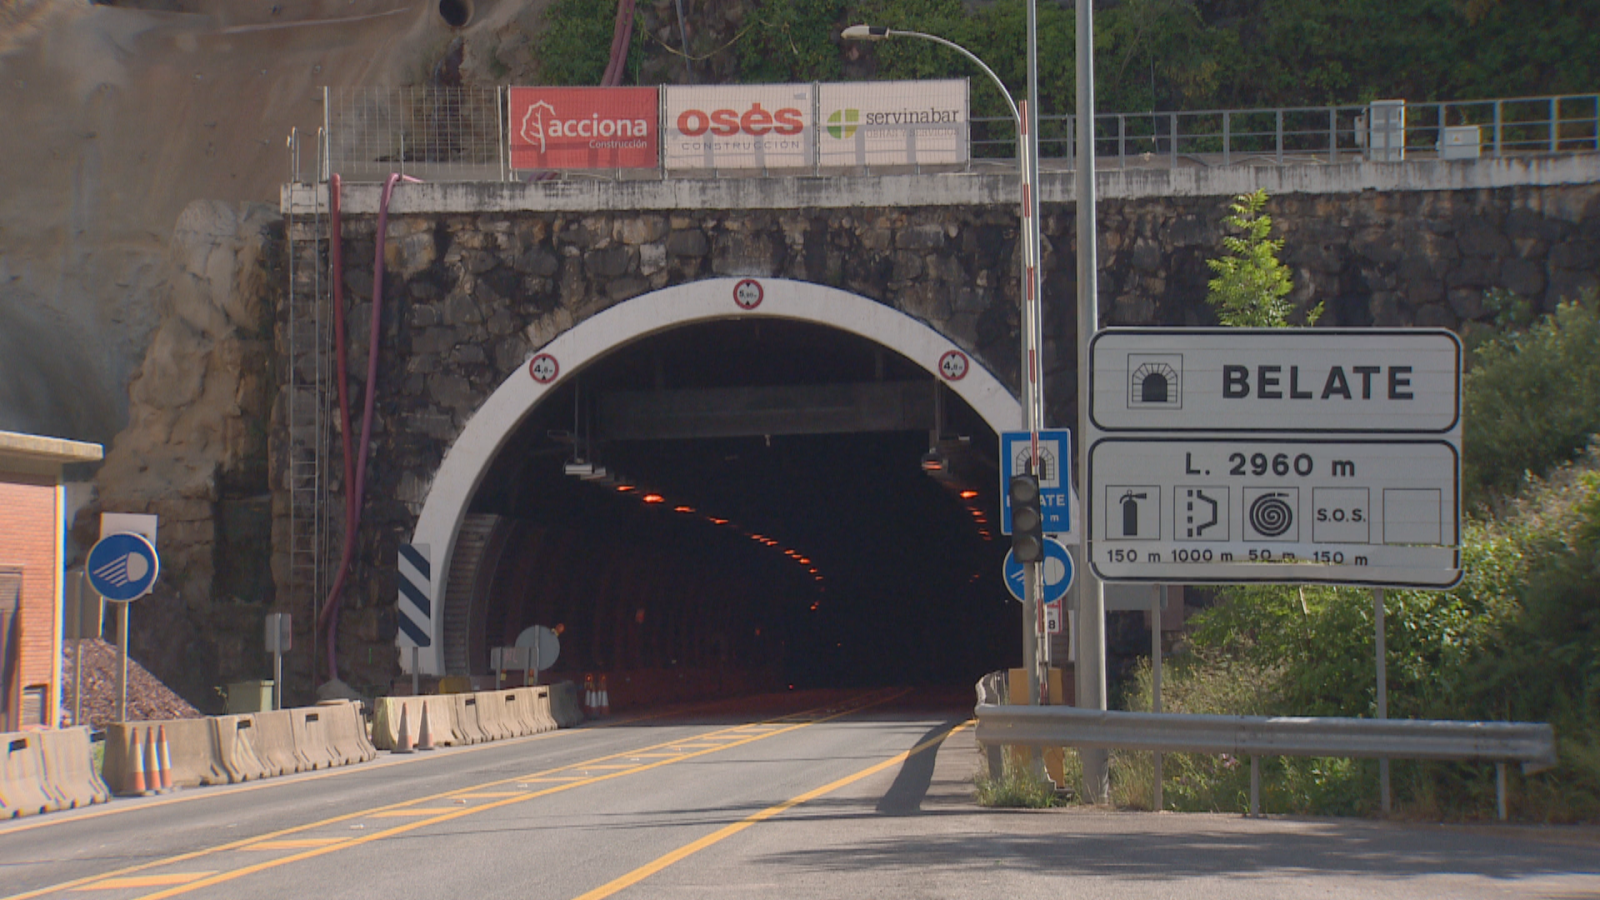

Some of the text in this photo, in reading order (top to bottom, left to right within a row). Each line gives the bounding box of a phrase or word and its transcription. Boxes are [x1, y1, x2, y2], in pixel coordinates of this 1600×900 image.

[866, 107, 959, 125] servinabar
[548, 112, 647, 137] acciona
[589, 139, 647, 149] Construcción
[681, 140, 800, 151] CONSTRUCCIÓN
[1222, 364, 1414, 400] BELATE
[1186, 452, 1355, 477] L. 2960 m
[1317, 508, 1366, 522] S.O.S.
[1107, 549, 1161, 562] 150 m
[1171, 549, 1233, 562] 1000 m
[1248, 549, 1271, 561] 50
[1313, 551, 1368, 566] 150 m
